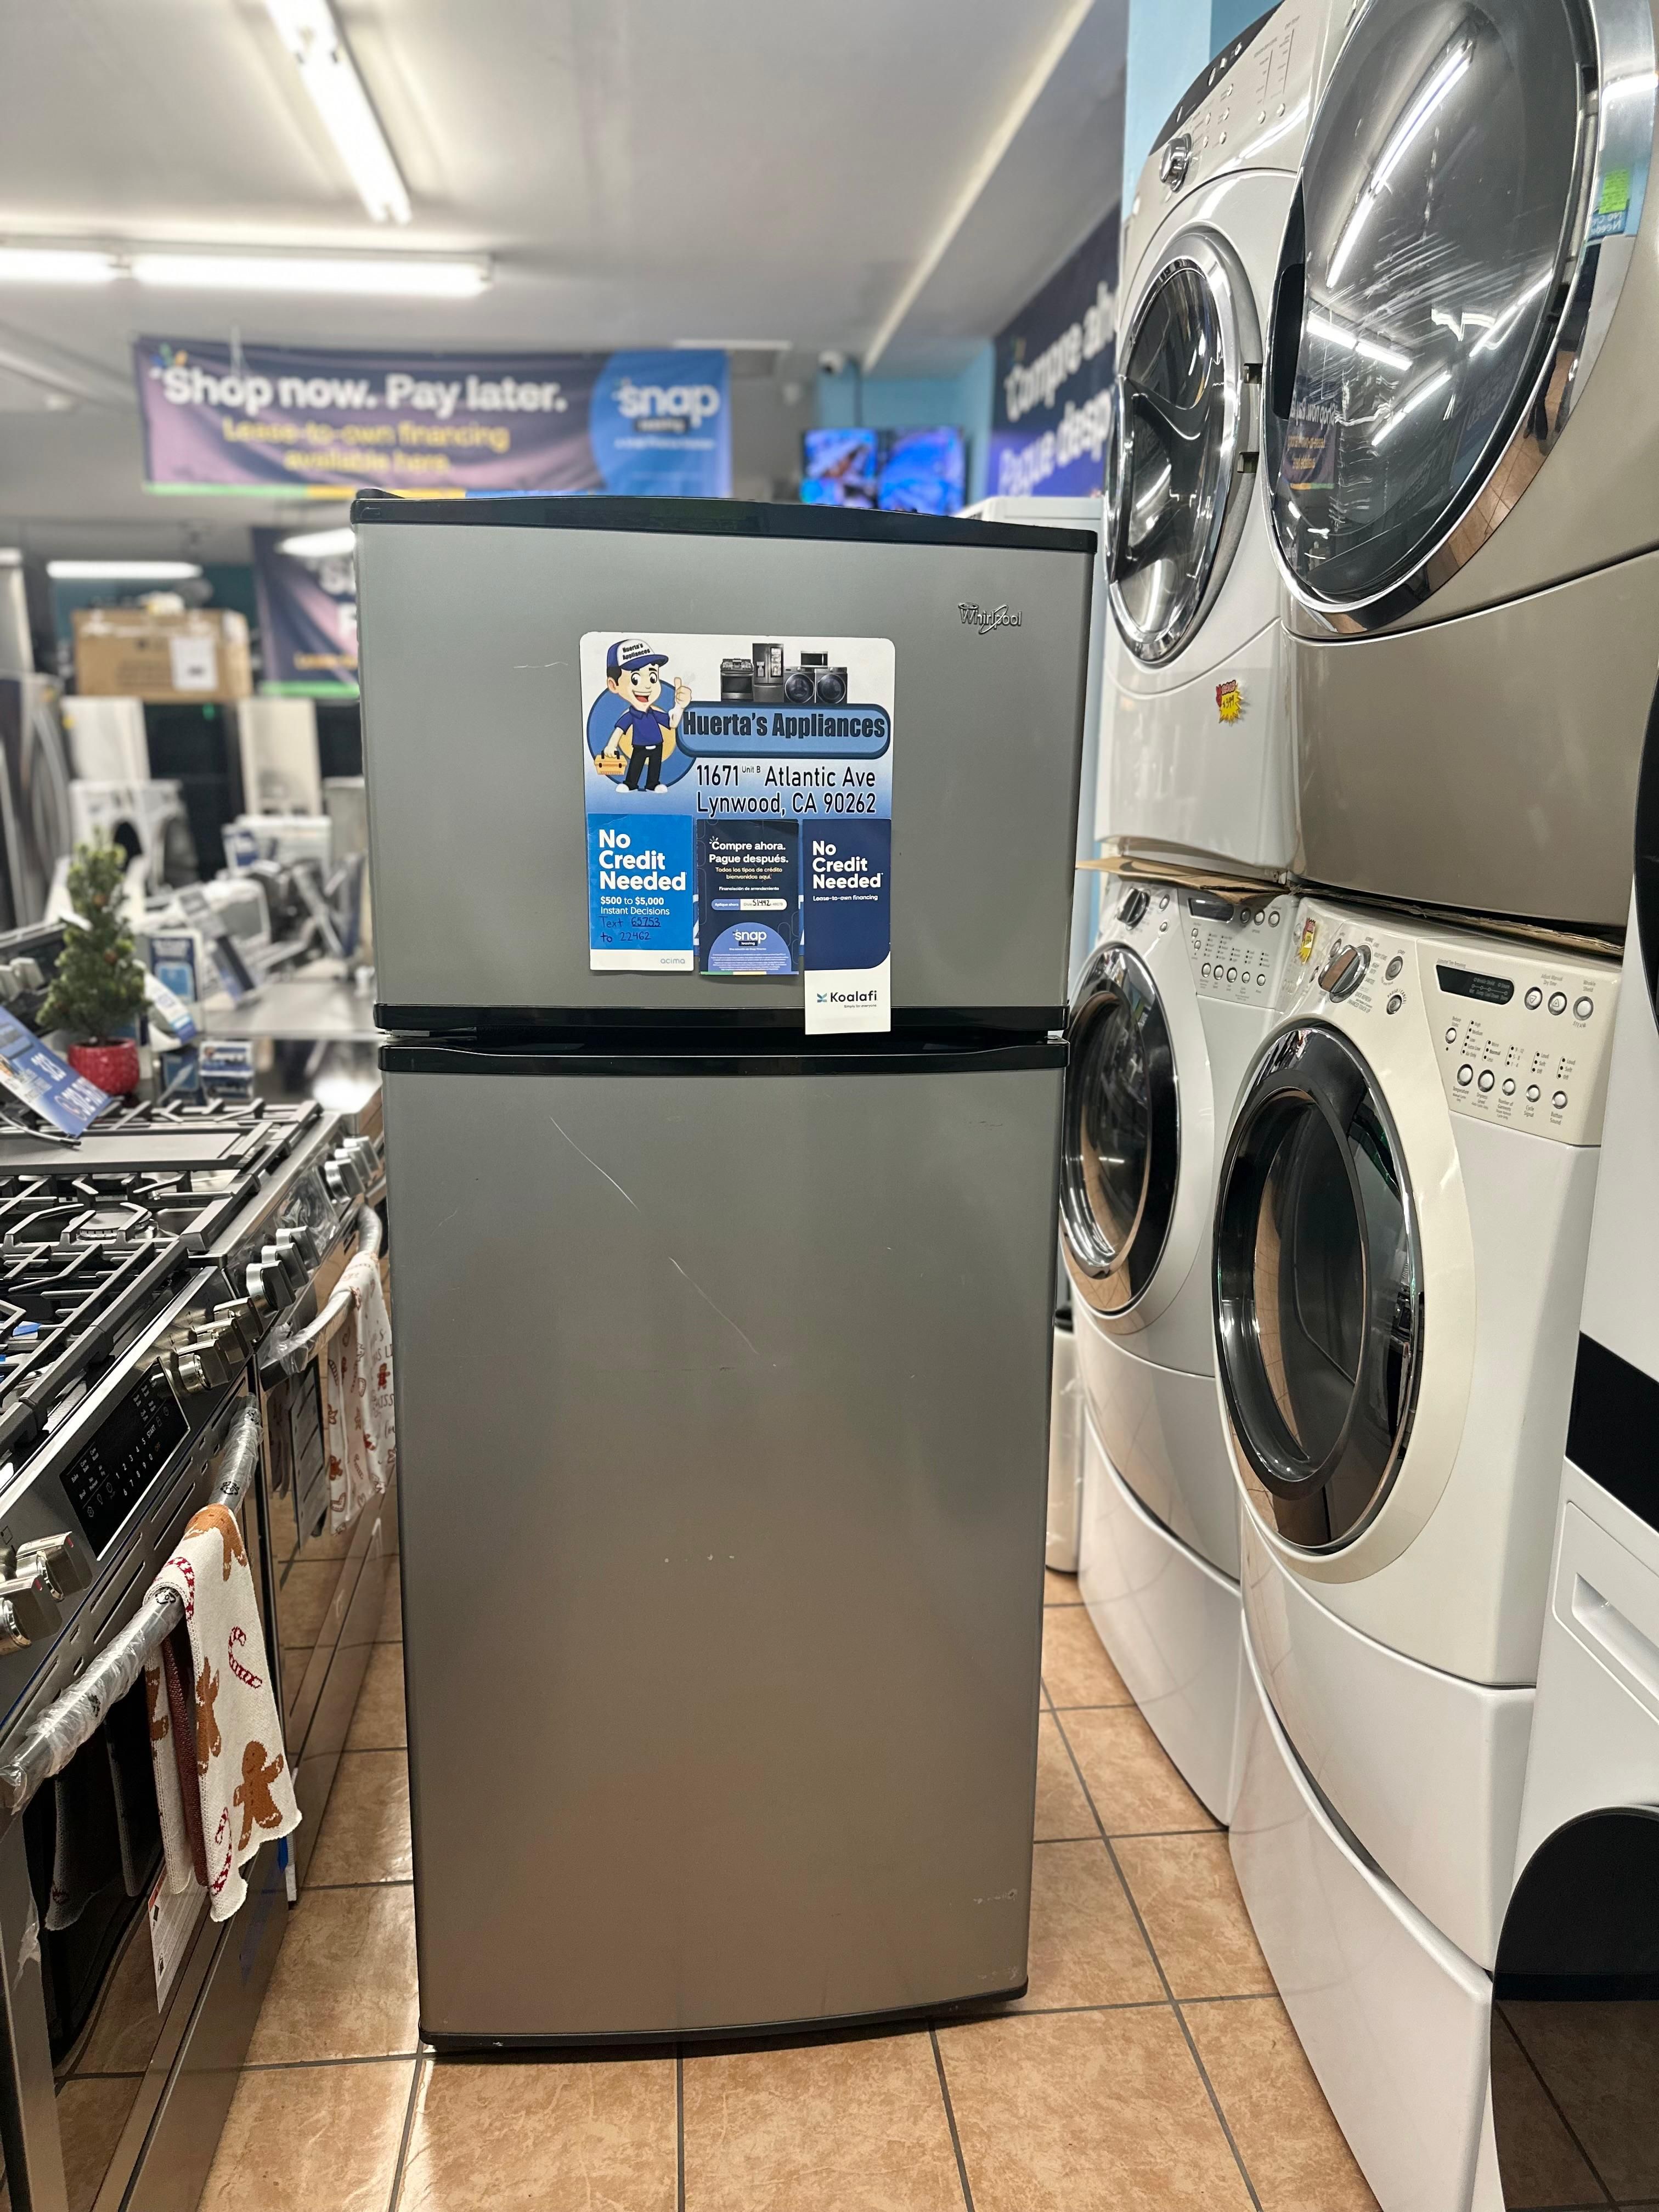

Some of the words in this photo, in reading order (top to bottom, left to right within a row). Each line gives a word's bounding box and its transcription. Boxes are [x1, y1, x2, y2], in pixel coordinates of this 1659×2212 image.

[163, 366, 274, 416] Shop
[278, 376, 378, 409] now.
[385, 373, 461, 419] Pay
[466, 375, 567, 412] later.
[618, 385, 719, 429] snap
[398, 420, 510, 454] financing
[959, 603, 1022, 633] Whirlpool
[623, 643, 644, 653] Huerta's
[623, 648, 651, 660] Appliances
[683, 712, 768, 736] Huerta's
[772, 713, 885, 739] Appliances
[697, 764, 738, 786] 11671
[742, 765, 755, 773] Unit
[757, 765, 761, 774] B
[764, 765, 837, 787] Atlantic
[842, 765, 876, 787] Ave
[697, 791, 786, 817] Lynwood,
[792, 793, 817, 814] CA
[823, 792, 876, 814] 90262
[599, 829, 631, 849] No
[712, 840, 752, 852] Compre
[754, 842, 786, 850] ahora.
[812, 840, 837, 856] No
[599, 850, 666, 870] Credit
[709, 854, 741, 865] Pague
[743, 854, 789, 865] después.
[812, 856, 868, 872] Credit
[600, 896, 622, 905] $500
[635, 897, 664, 906] $5,000
[601, 906, 629, 915] Instant
[630, 906, 670, 915] Decisions
[599, 916, 624, 928] Text
[631, 916, 661, 927] 65753
[600, 932, 613, 943] to
[619, 931, 652, 941] 22462
[735, 931, 767, 944] snap
[830, 990, 877, 1002] Koalafi
[1550, 1117, 1561, 1125] Sound
[146, 1424, 156, 1438] START
[123, 1488, 127, 1496] 6
